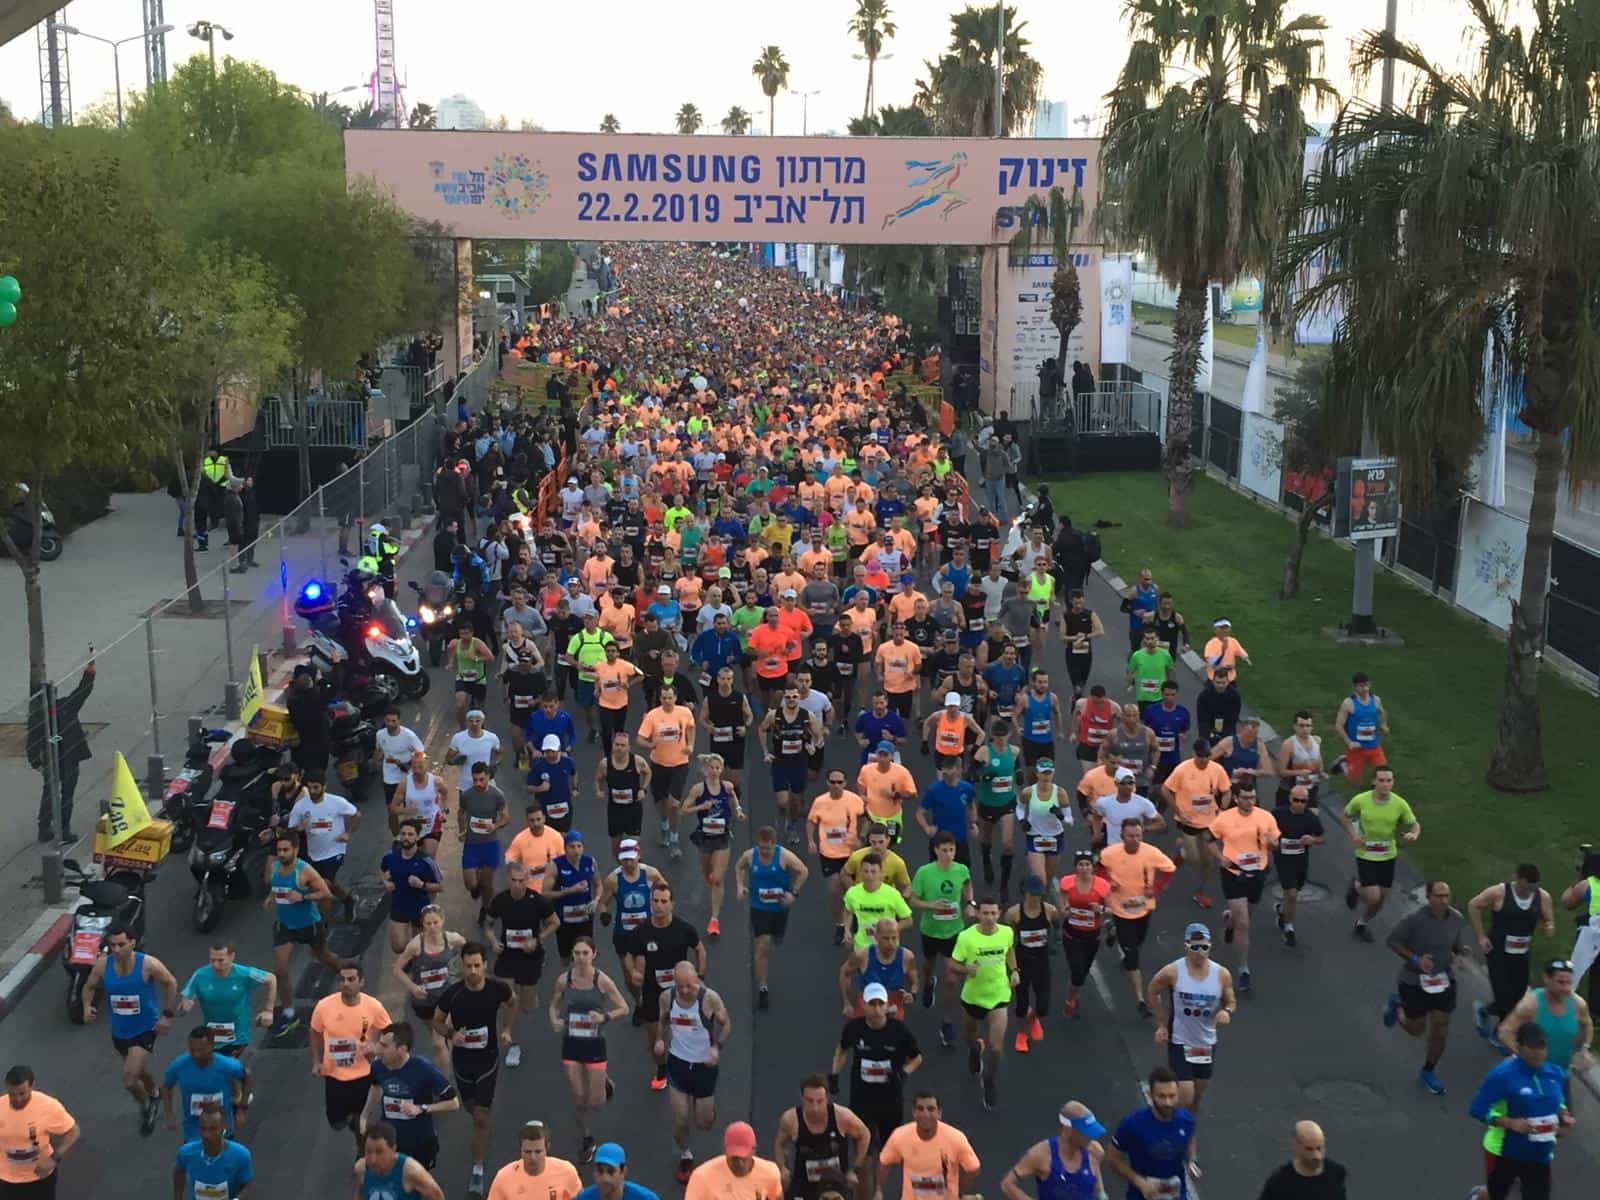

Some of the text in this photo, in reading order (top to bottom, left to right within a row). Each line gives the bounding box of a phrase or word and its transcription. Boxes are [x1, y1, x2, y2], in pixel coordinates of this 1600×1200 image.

[577, 152, 865, 188] מרתון SAMSUNG
[999, 158, 1087, 195] זינוק
[577, 192, 720, 223] 22.2.2019
